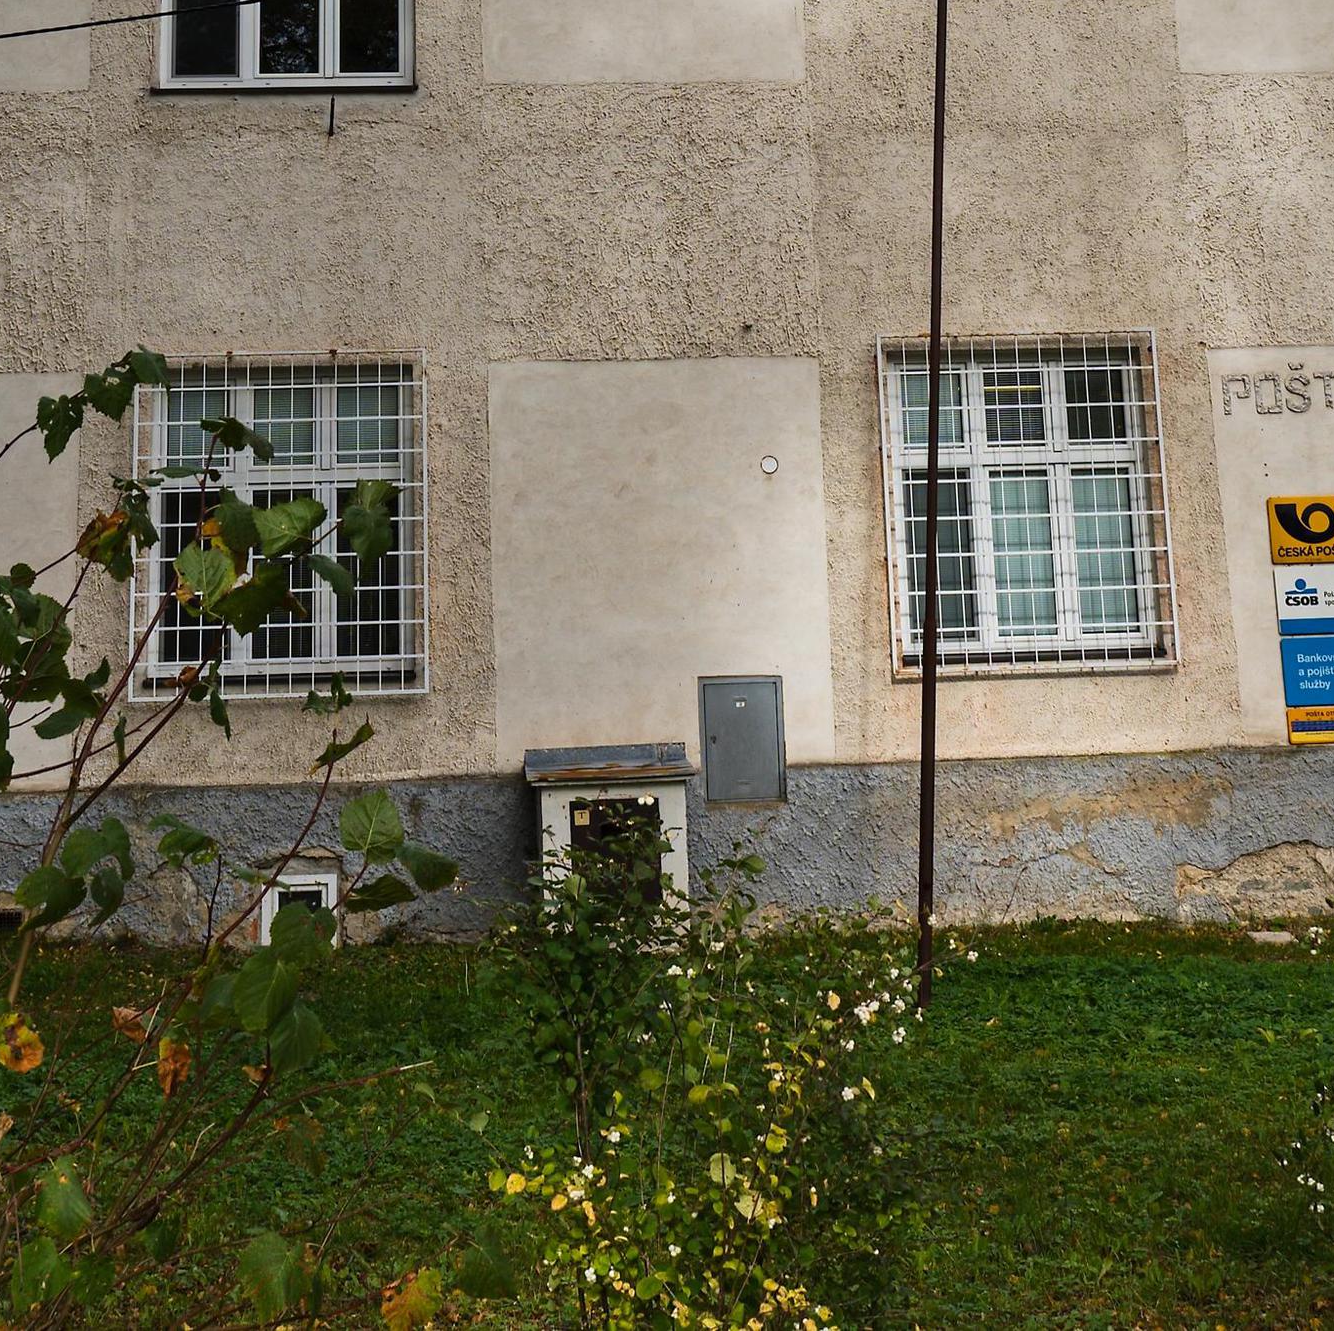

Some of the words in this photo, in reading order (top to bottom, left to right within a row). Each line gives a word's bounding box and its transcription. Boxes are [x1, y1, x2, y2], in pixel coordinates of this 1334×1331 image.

[1278, 545, 1315, 558] ČESKÁ
[1285, 595, 1319, 606] ČSOB
[1298, 668, 1305, 676] a
[1299, 679, 1331, 690] služby
